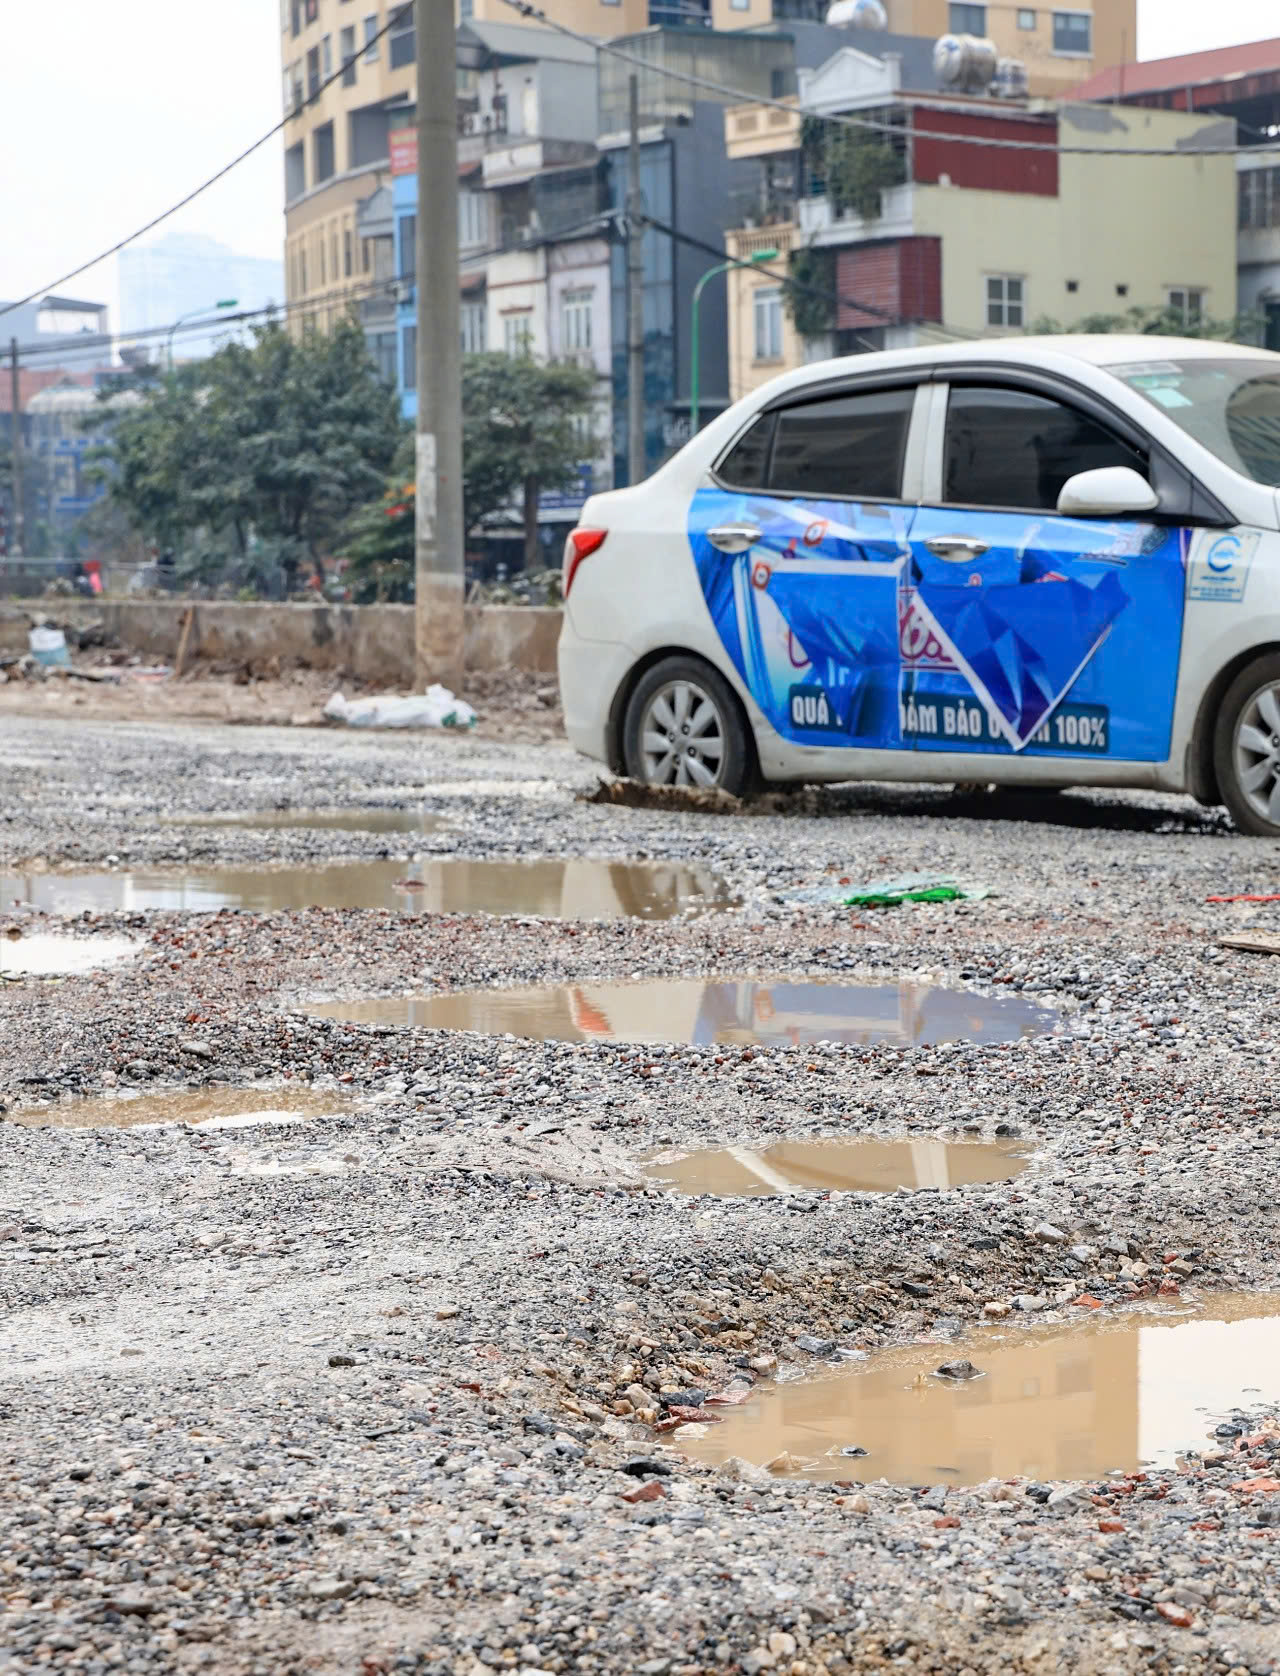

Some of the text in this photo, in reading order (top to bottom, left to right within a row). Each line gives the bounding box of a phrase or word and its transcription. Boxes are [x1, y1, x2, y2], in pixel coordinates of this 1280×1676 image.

[792, 692, 829, 725] QUÁ
[943, 700, 982, 737] BẢO
[1055, 715, 1105, 747] 100%
